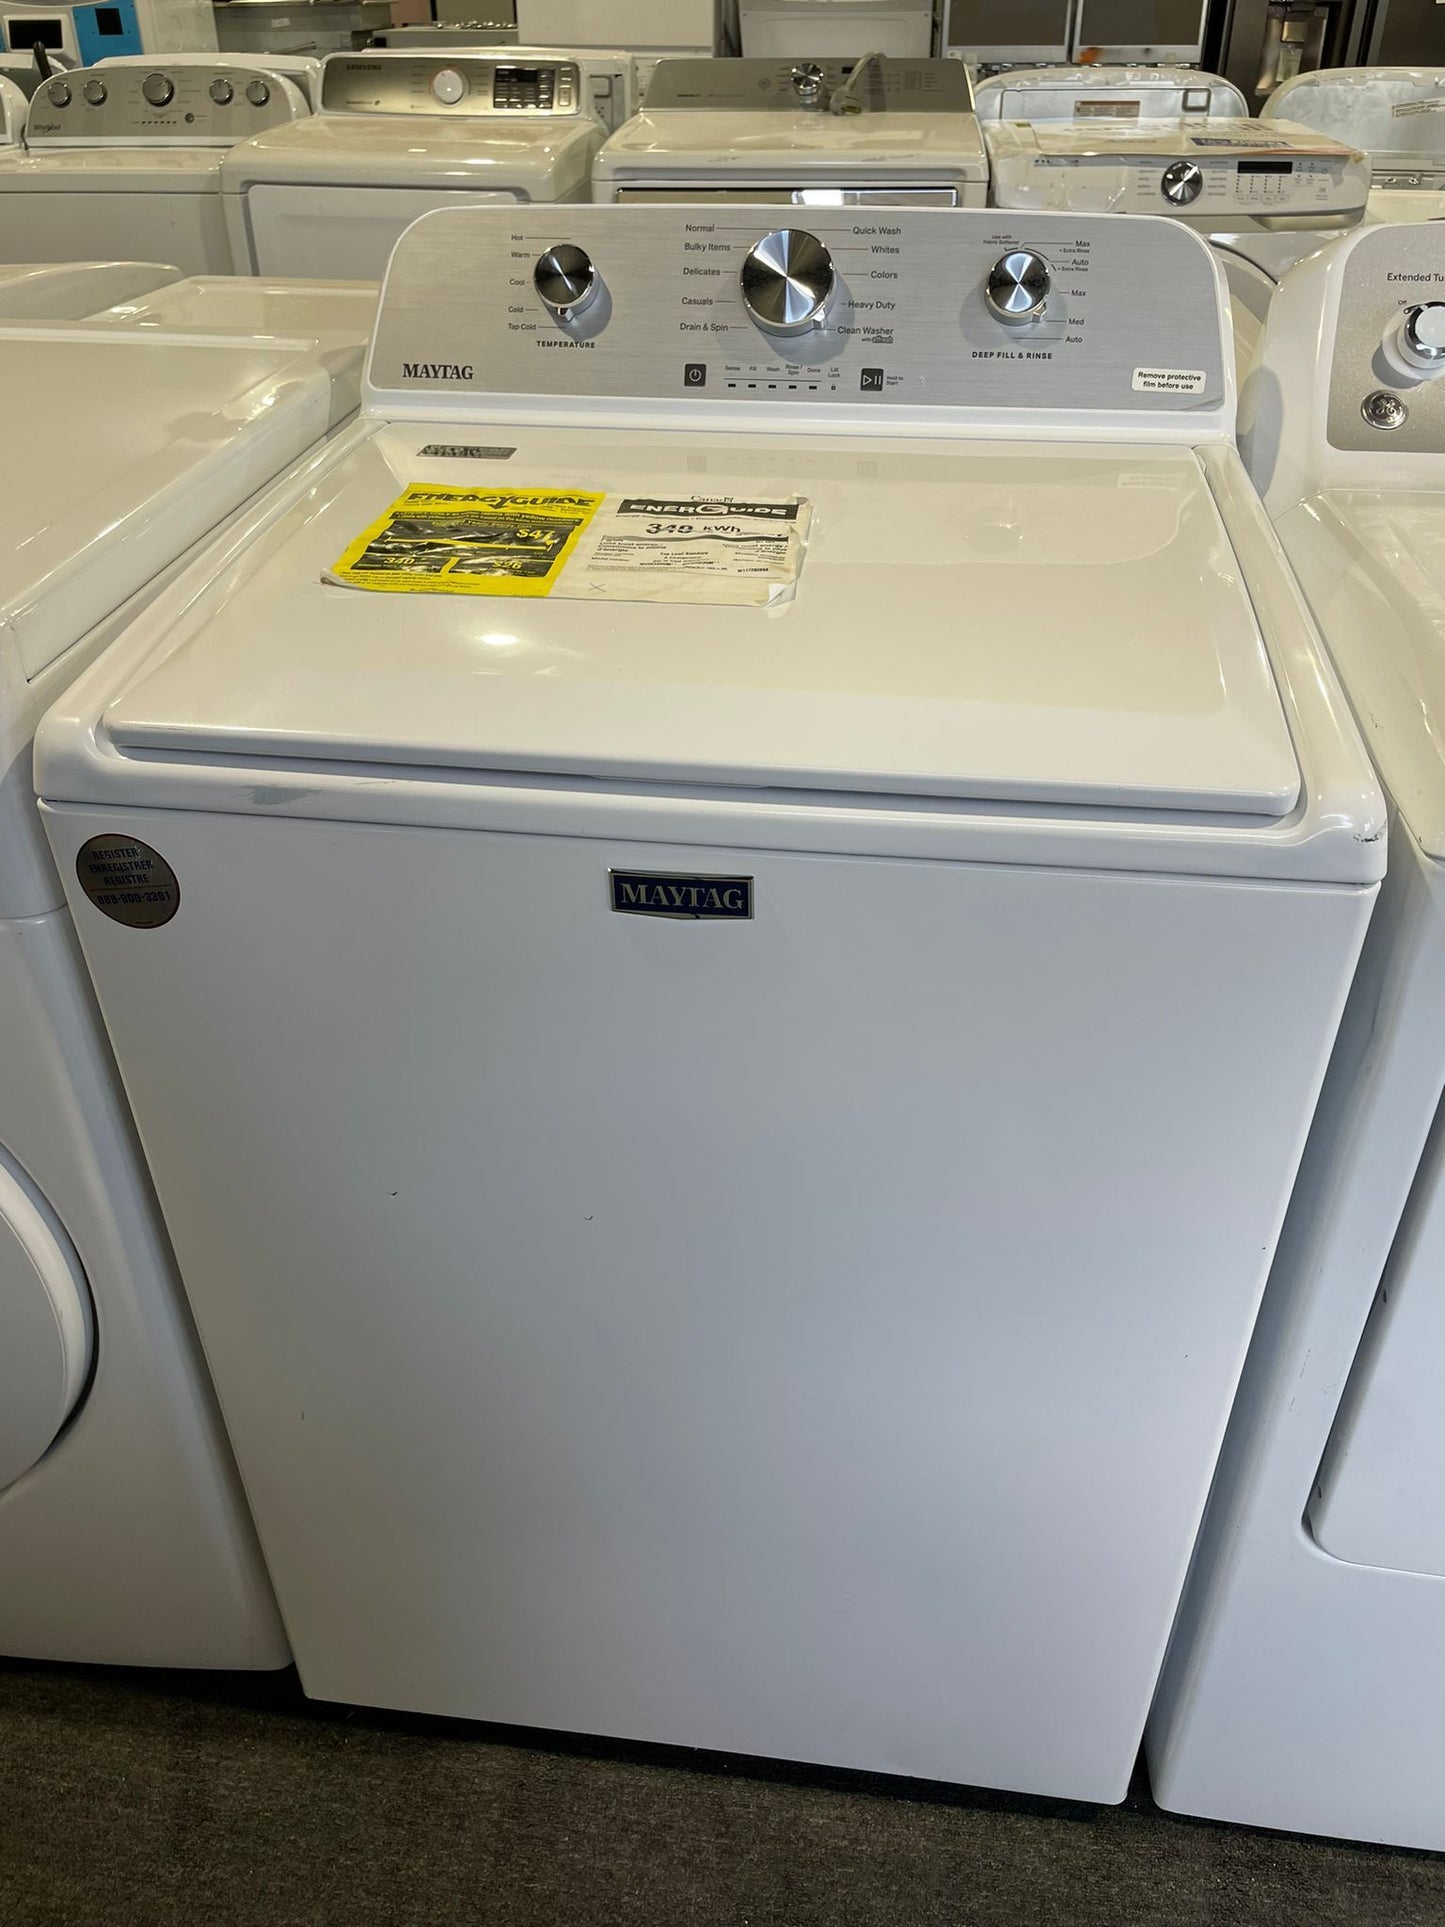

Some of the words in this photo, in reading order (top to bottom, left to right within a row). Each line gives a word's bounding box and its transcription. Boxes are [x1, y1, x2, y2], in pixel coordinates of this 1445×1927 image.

[685, 224, 715, 232] Normal
[853, 226, 877, 235] Quick
[878, 227, 902, 235] Wash
[684, 242, 707, 252] Bulky
[708, 243, 731, 251] Items
[871, 246, 900, 254] Whites
[1071, 258, 1089, 266] Auto
[683, 267, 721, 276] Delicates
[870, 271, 898, 279] Colors
[1387, 272, 1432, 282] Extended
[509, 278, 525, 286] Cool
[1071, 289, 1087, 297] Max
[681, 296, 714, 306] Casuals
[848, 300, 874, 310] Heavy
[875, 301, 896, 311] Duty
[1068, 318, 1084, 326] Med
[508, 323, 520, 331] Tap
[520, 323, 537, 331] Cold
[680, 322, 701, 331] Drain
[702, 323, 709, 331] &
[710, 323, 729, 333] Spin
[837, 326, 861, 335] Clean
[862, 326, 894, 335] Washer
[1065, 335, 1083, 343] Auto
[536, 340, 596, 349] TEMPERATURE
[971, 351, 995, 359] DEEP
[997, 351, 1016, 359] FILL
[1026, 352, 1053, 360] RINSE
[402, 363, 474, 380] MAYTAG
[1138, 371, 1166, 380] Remove
[91, 847, 139, 860] REGISTER
[619, 882, 744, 910] MAYTAG
